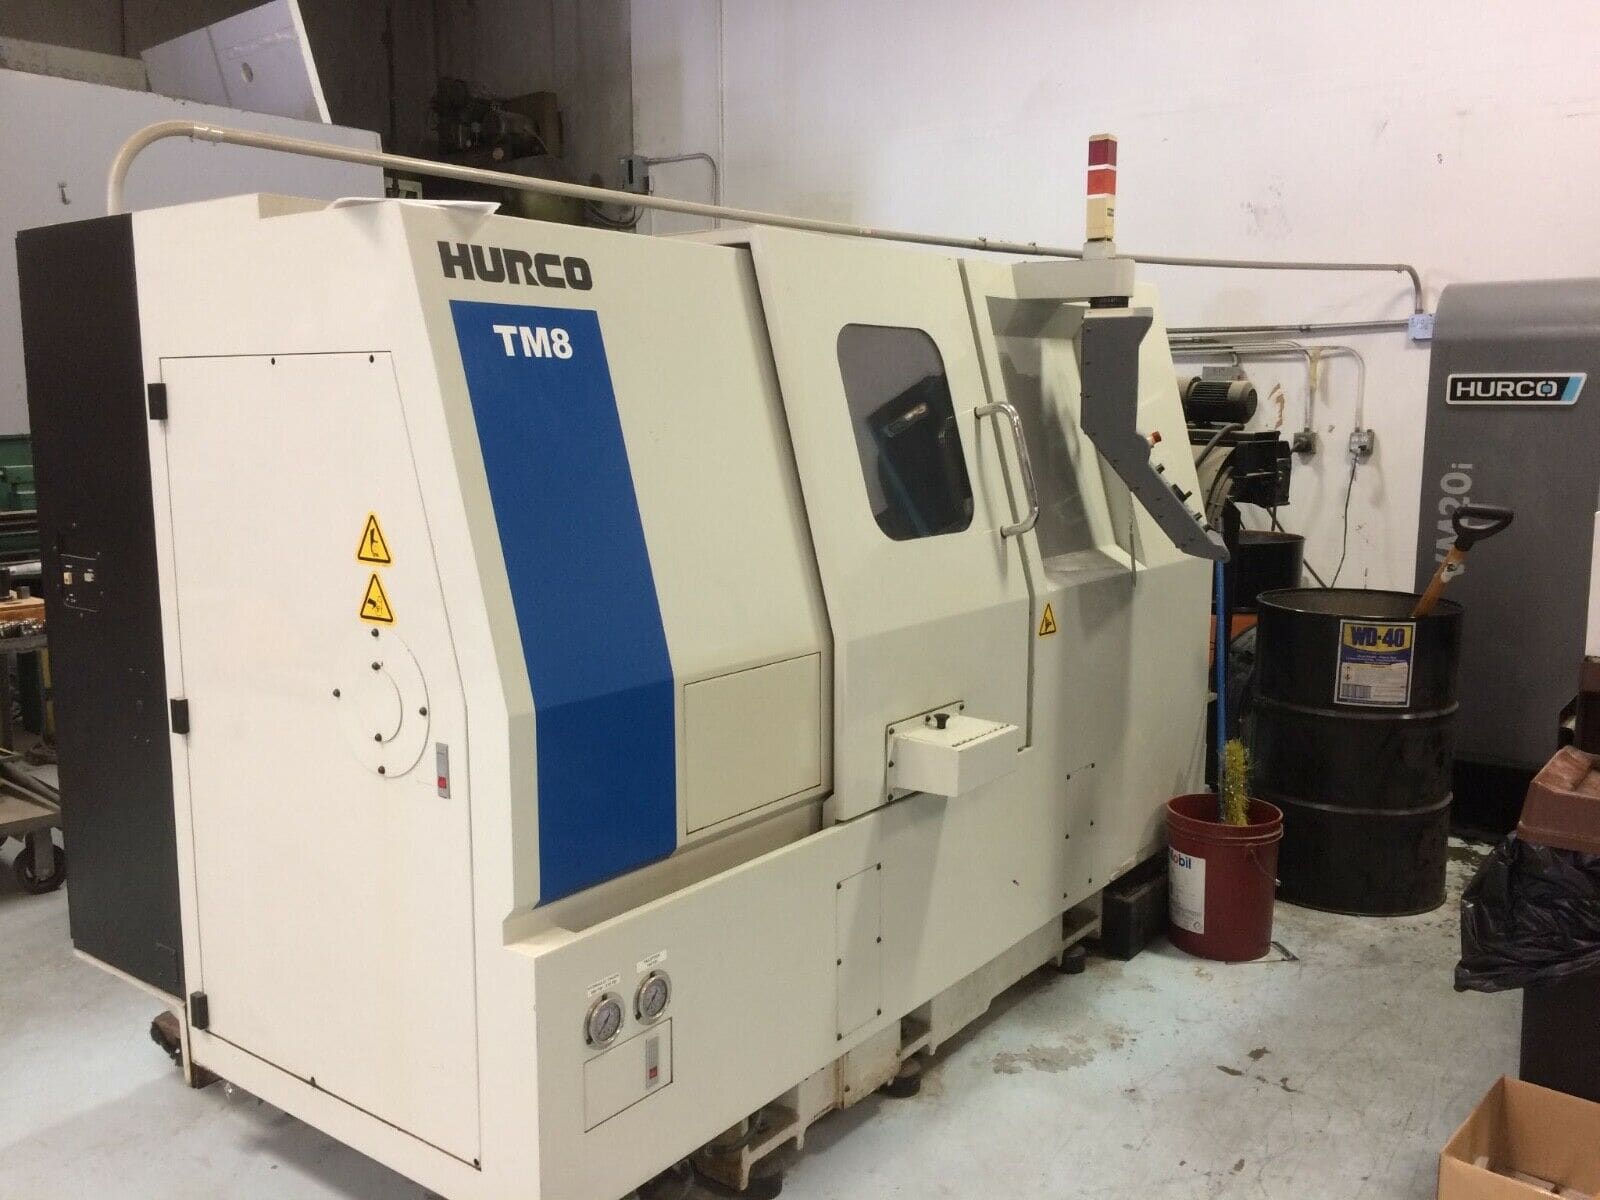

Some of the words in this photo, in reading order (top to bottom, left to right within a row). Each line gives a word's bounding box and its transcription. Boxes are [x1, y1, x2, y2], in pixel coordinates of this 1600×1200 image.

[437, 240, 593, 291] HURCO
[493, 325, 574, 359] TM8
[1455, 380, 1557, 398] HURCO
[1352, 627, 1405, 648] WD-40
